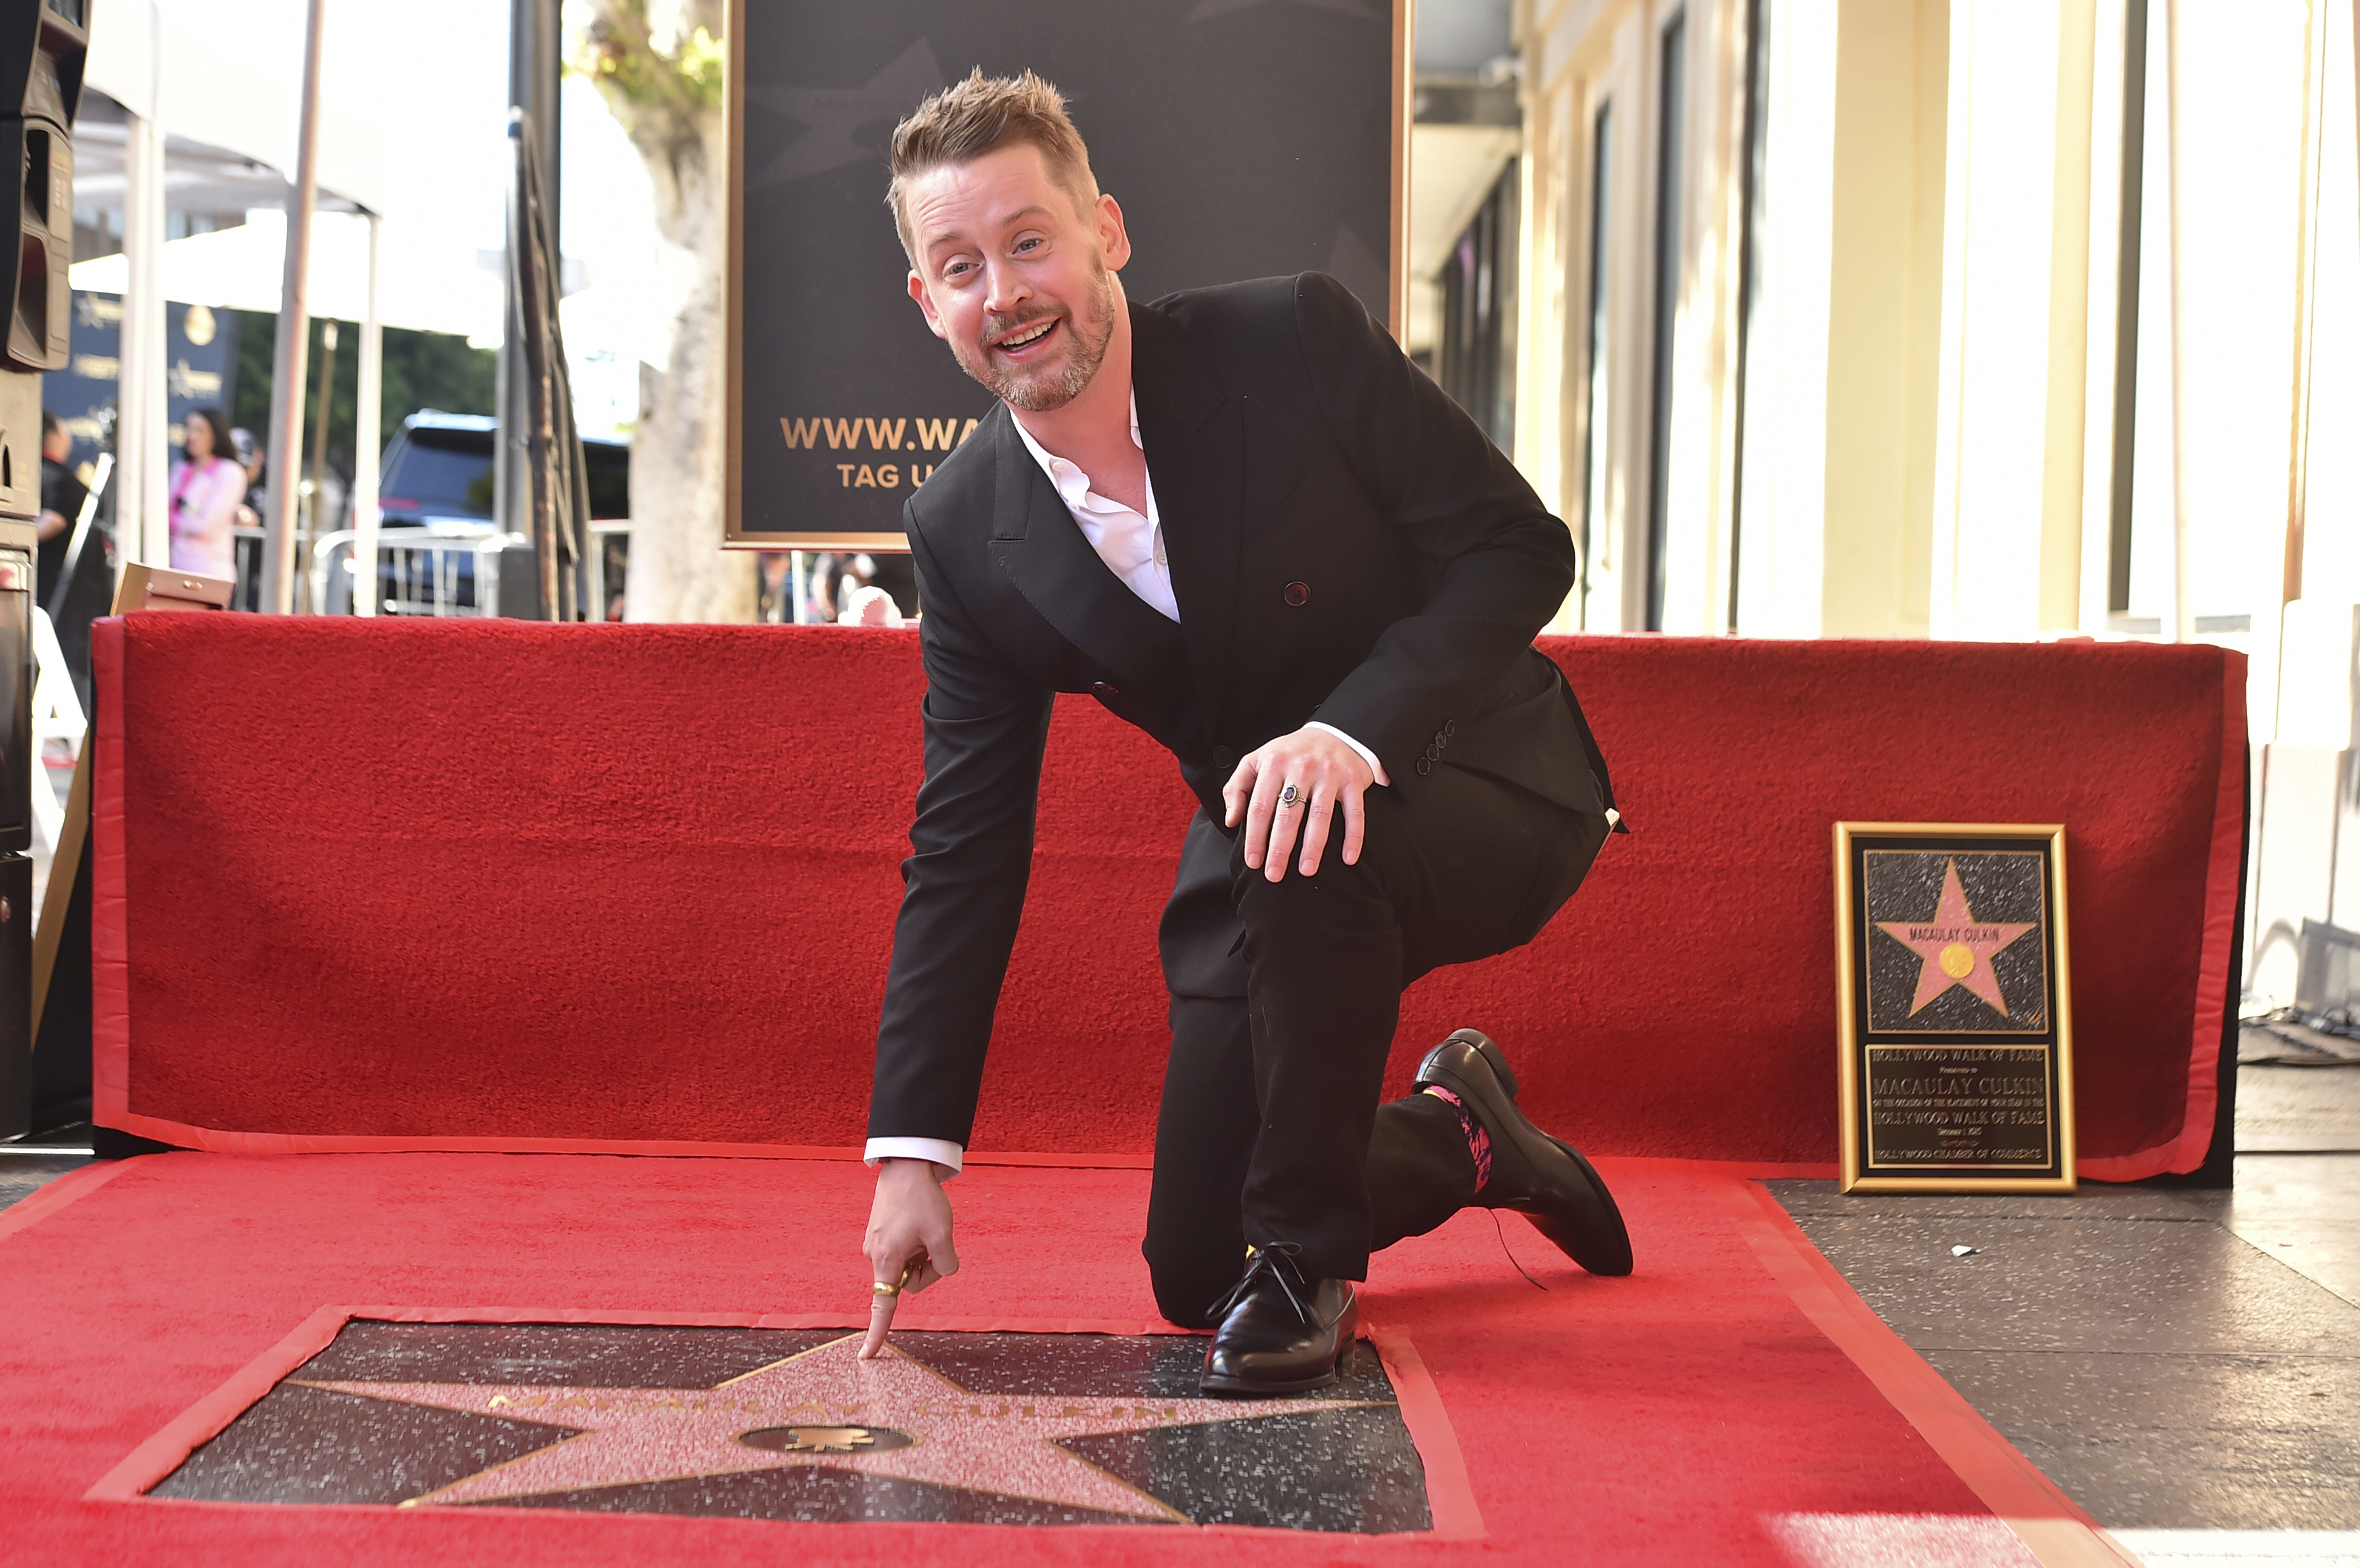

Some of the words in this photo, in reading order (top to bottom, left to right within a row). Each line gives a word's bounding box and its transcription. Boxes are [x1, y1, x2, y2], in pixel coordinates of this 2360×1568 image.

[836, 464, 899, 488] TAG
[1909, 928, 1960, 942] MACAULAY
[1964, 928, 1999, 942] CULKIN
[1872, 1050, 1948, 1061] HOLLYWOOD
[1951, 1050, 1986, 1061] WALK
[1990, 1050, 2004, 1061] OF
[2009, 1050, 2043, 1061] FAME
[1874, 1078, 1972, 1095] MACAULAY
[1979, 1077, 2044, 1094] CULKIN
[1873, 1112, 1949, 1124] HOLLYWOOD
[1951, 1112, 1989, 1124] WALK
[1992, 1112, 2006, 1124] OF
[2010, 1112, 2045, 1124] FAME
[1874, 1150, 1933, 1159] HOLLYWOOD
[1933, 1149, 1975, 1159] CHAMBER
[1976, 1149, 1989, 1159] OF
[1990, 1149, 2043, 1159] COMMERCE
